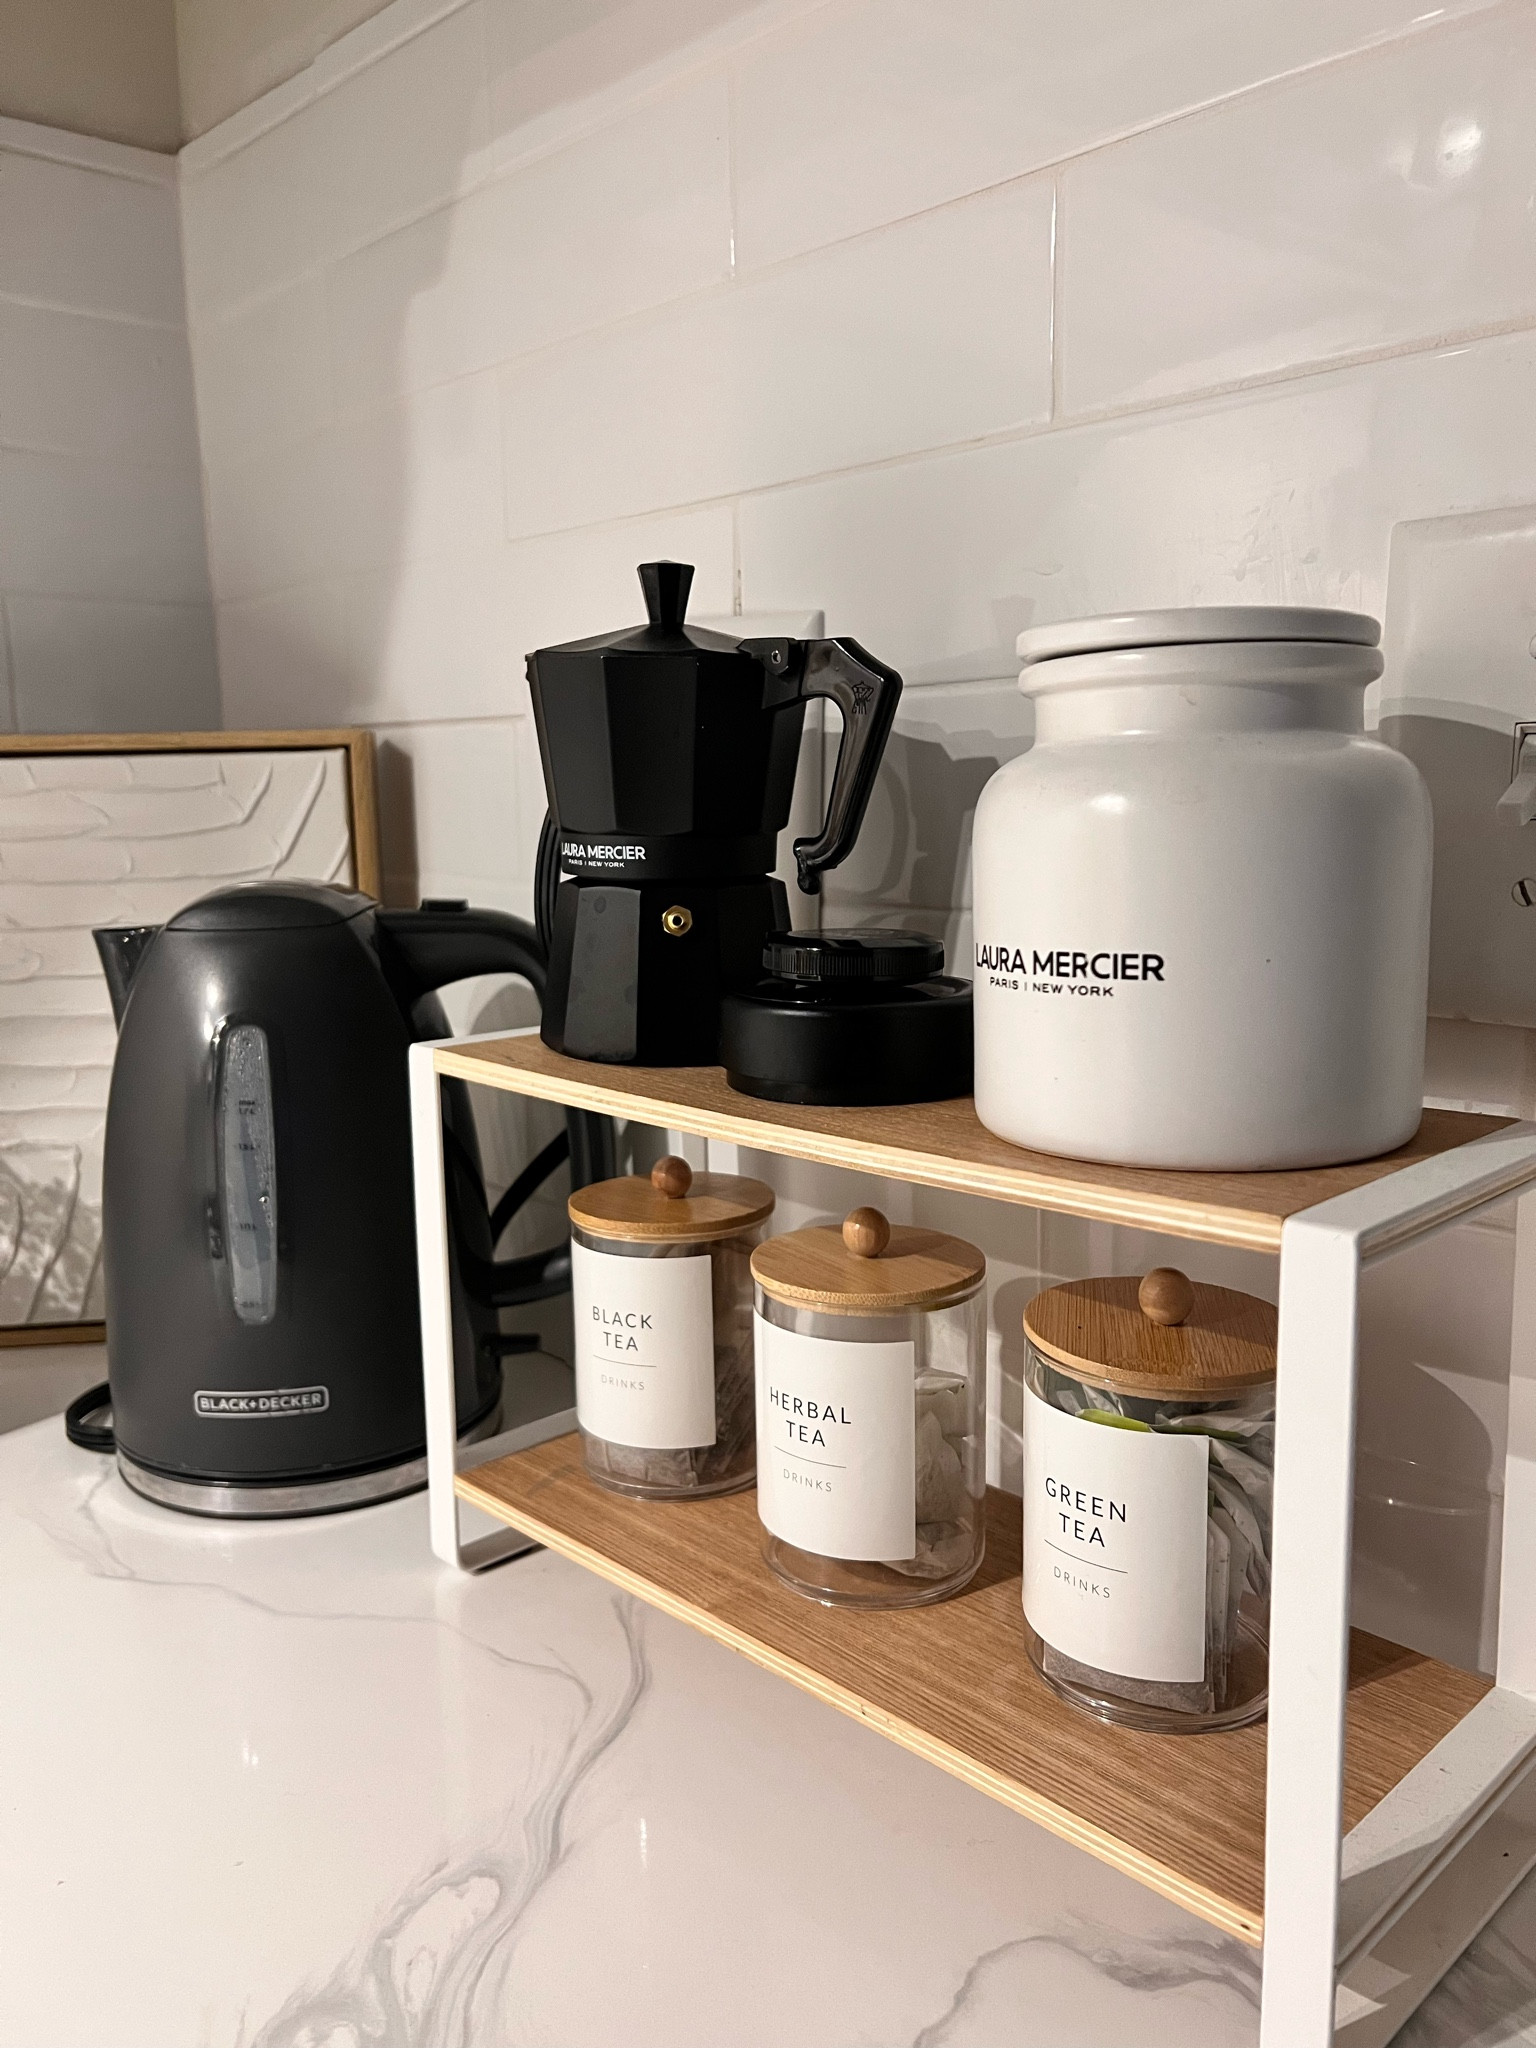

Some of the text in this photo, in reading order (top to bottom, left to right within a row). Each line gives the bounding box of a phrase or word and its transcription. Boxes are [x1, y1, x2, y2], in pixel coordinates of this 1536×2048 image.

[561, 842, 647, 860] LAURA MERCIER
[568, 858, 583, 866] PARIS
[975, 942, 1165, 981] LAURA MERCIER
[990, 977, 1019, 990] PARIS
[1032, 983, 1063, 994] NEW
[1068, 985, 1115, 997] YORK
[591, 1305, 653, 1330] BLACK
[602, 1331, 639, 1352] TEA
[600, 1374, 645, 1391] DRINKS
[770, 1386, 852, 1425] HERBAL
[786, 1419, 826, 1448] TEA
[783, 1468, 833, 1492] DRINKS
[1045, 1477, 1126, 1523] GREEN
[1058, 1512, 1106, 1548] TEA
[1053, 1565, 1111, 1599] DRINKS
